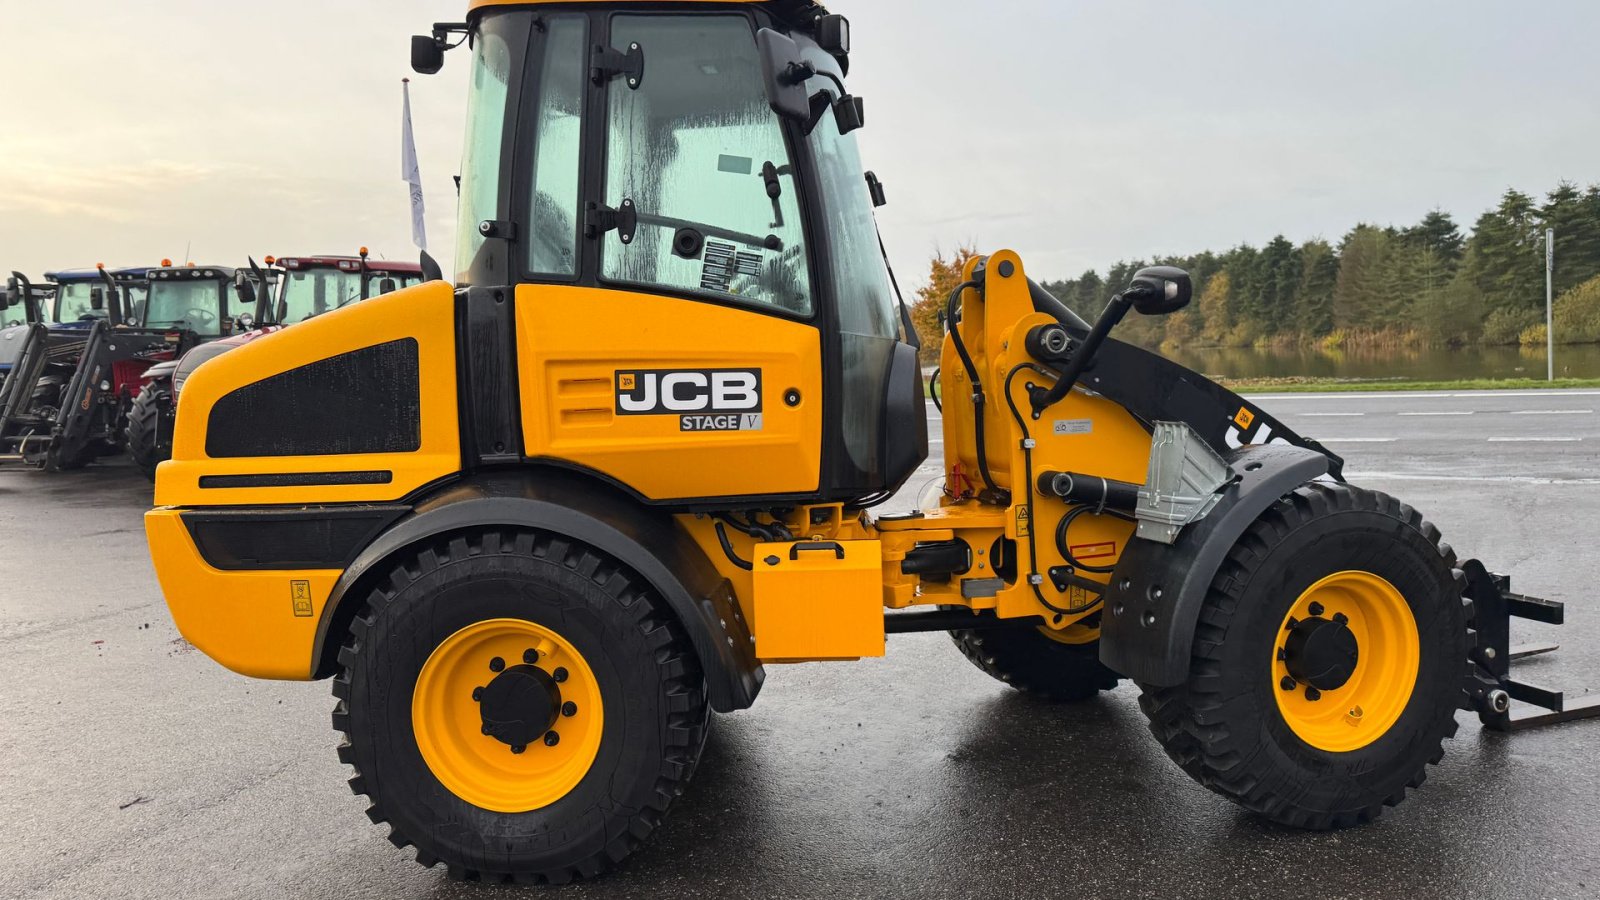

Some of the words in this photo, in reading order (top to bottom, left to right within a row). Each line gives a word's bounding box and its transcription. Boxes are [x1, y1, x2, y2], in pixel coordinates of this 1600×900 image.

[619, 372, 759, 411] JCB
[682, 415, 737, 430] STAGE
[748, 415, 758, 429] V
